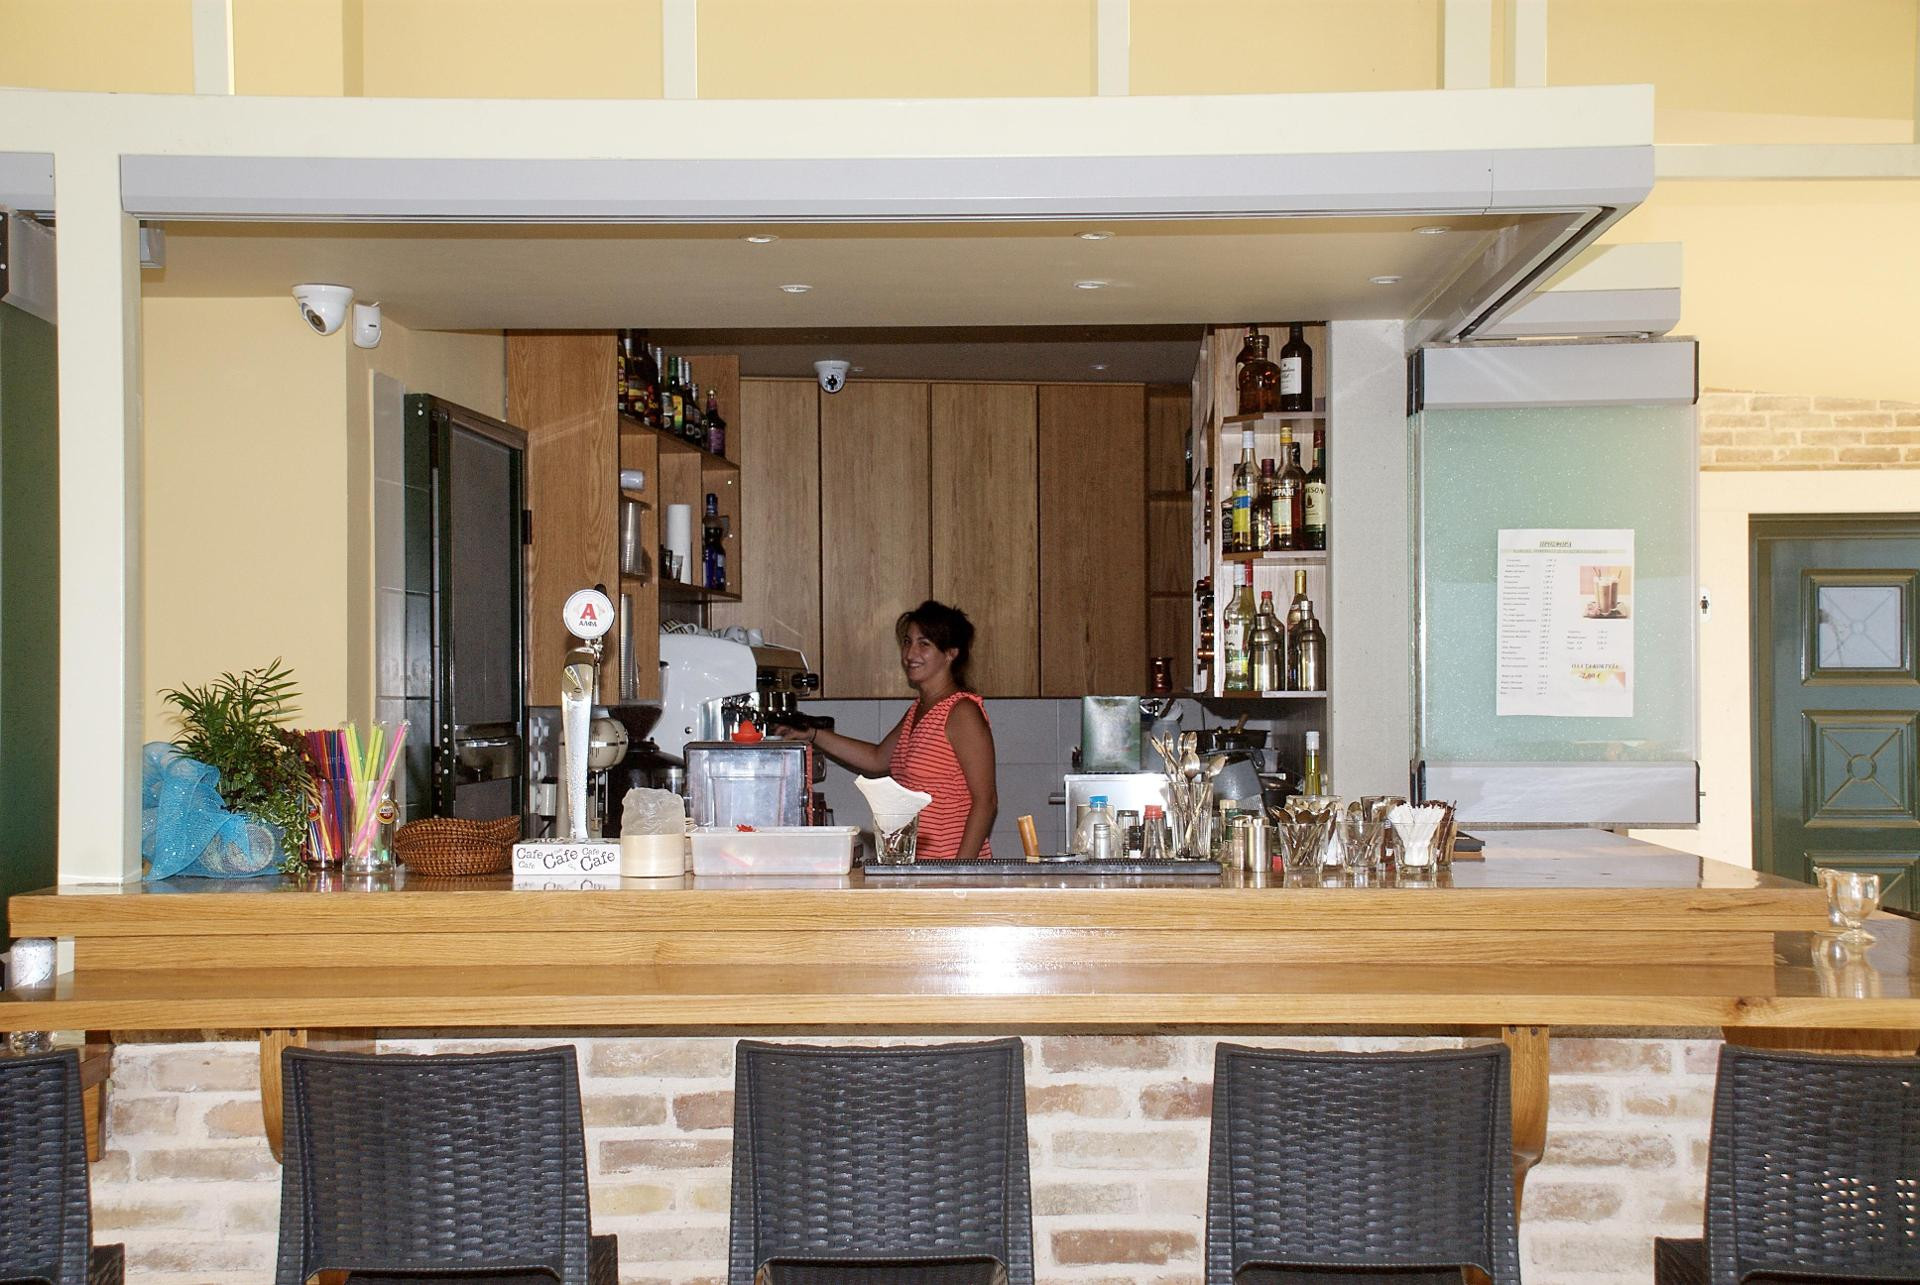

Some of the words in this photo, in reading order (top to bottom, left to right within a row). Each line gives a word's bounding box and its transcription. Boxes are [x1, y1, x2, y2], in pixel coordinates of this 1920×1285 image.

[516, 847, 543, 859] Cafe
[543, 849, 578, 869] Cafe
[580, 851, 615, 871] Cafe
